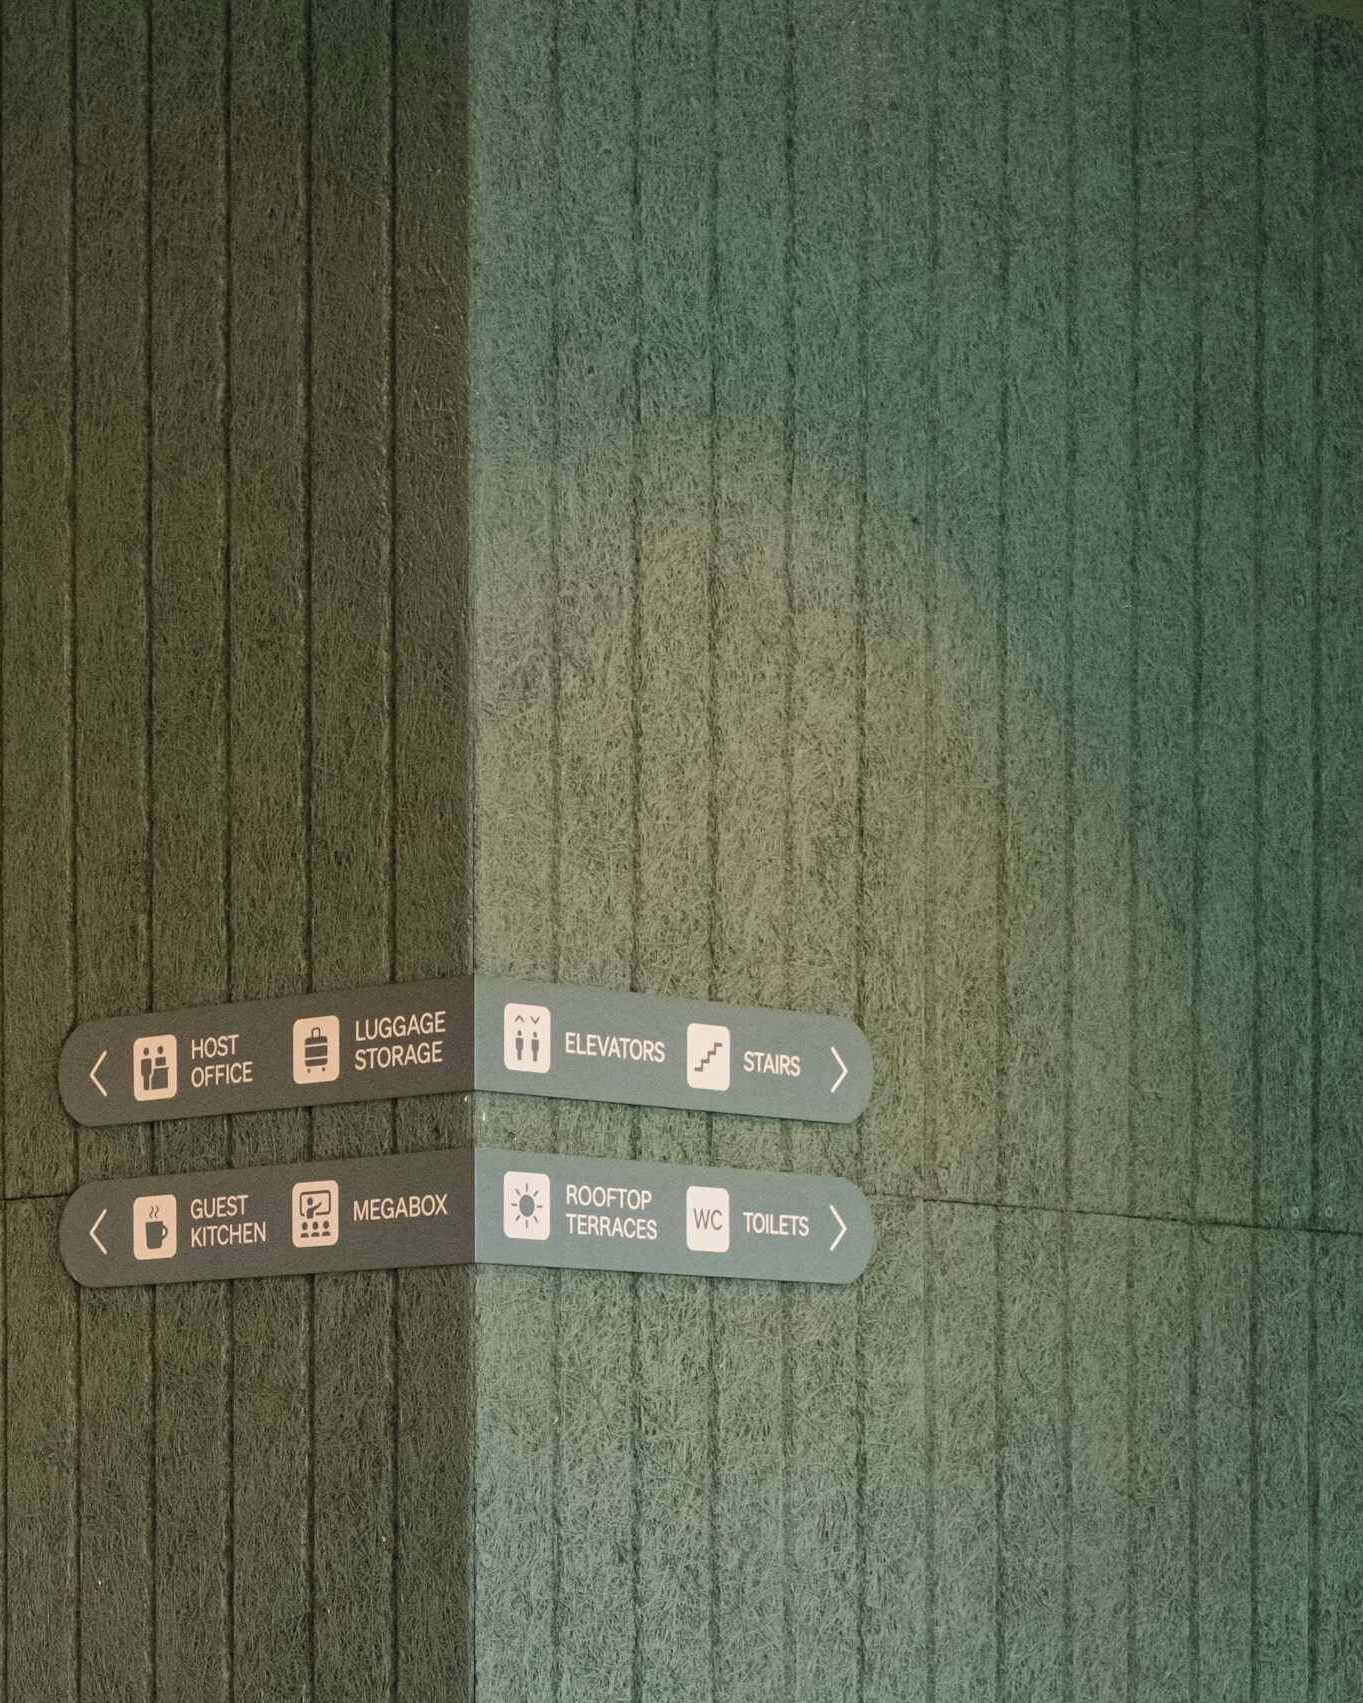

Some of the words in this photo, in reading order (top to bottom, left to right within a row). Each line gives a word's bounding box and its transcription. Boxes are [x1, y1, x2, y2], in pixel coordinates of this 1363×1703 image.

[356, 1011, 446, 1041] LUGGAGE
[192, 1034, 239, 1059] HOST
[355, 1041, 442, 1070] STORAGE
[566, 1032, 665, 1062] ELEVATORS
[191, 1061, 253, 1087] OFFICE
[744, 1051, 800, 1076] STAIRS
[191, 1195, 248, 1219] GUEST
[354, 1194, 447, 1221] MEGABOX
[567, 1184, 652, 1210] ROOFTOP
[566, 1214, 657, 1240] TERRACES
[694, 1208, 722, 1231] WC
[743, 1212, 809, 1236] TOILETS
[191, 1222, 266, 1247] KITCHEN
